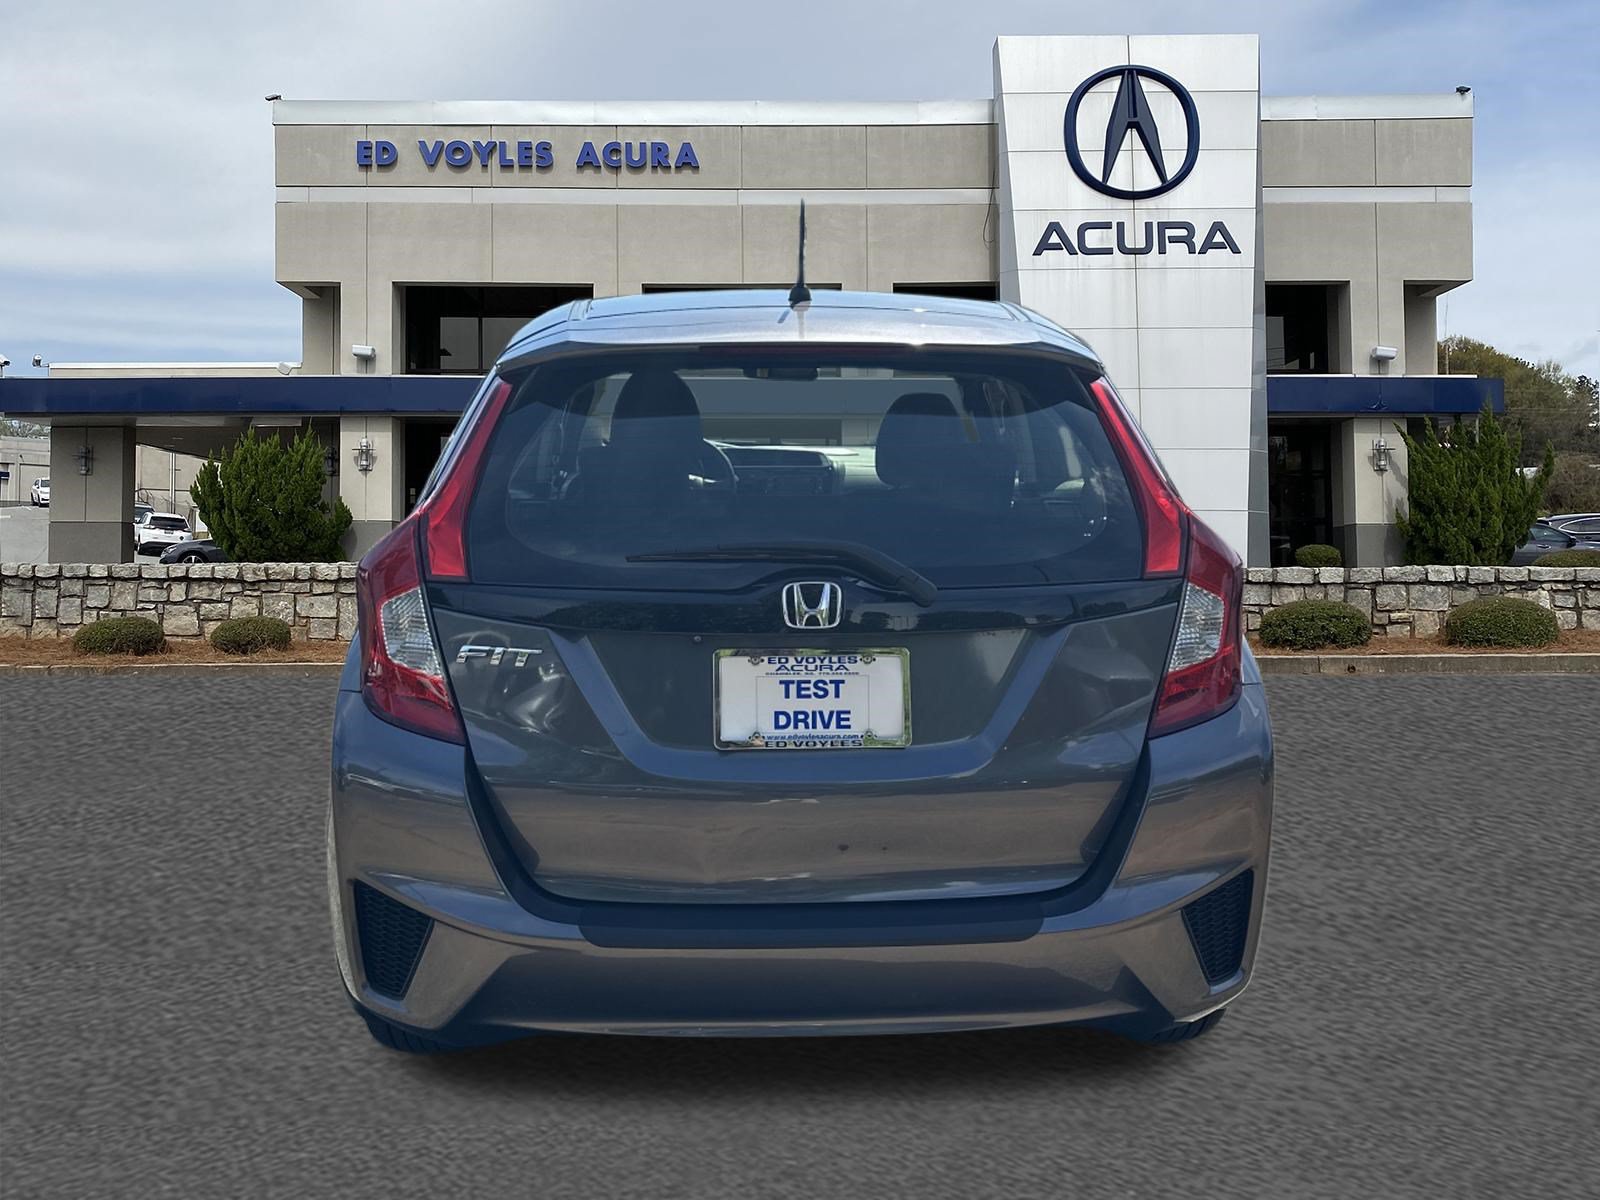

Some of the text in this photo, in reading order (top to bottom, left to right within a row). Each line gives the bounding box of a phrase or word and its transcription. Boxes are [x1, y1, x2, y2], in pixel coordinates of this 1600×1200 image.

[356, 140, 700, 169] ED VOYLES ACURA
[1032, 221, 1242, 256] ACURA
[455, 644, 543, 667] FIT
[767, 655, 858, 665] ED VOYLES
[775, 664, 850, 672] ACURA
[779, 679, 846, 699] TEST
[773, 710, 852, 730] DRIVE
[765, 740, 863, 748] ED VOYLES
